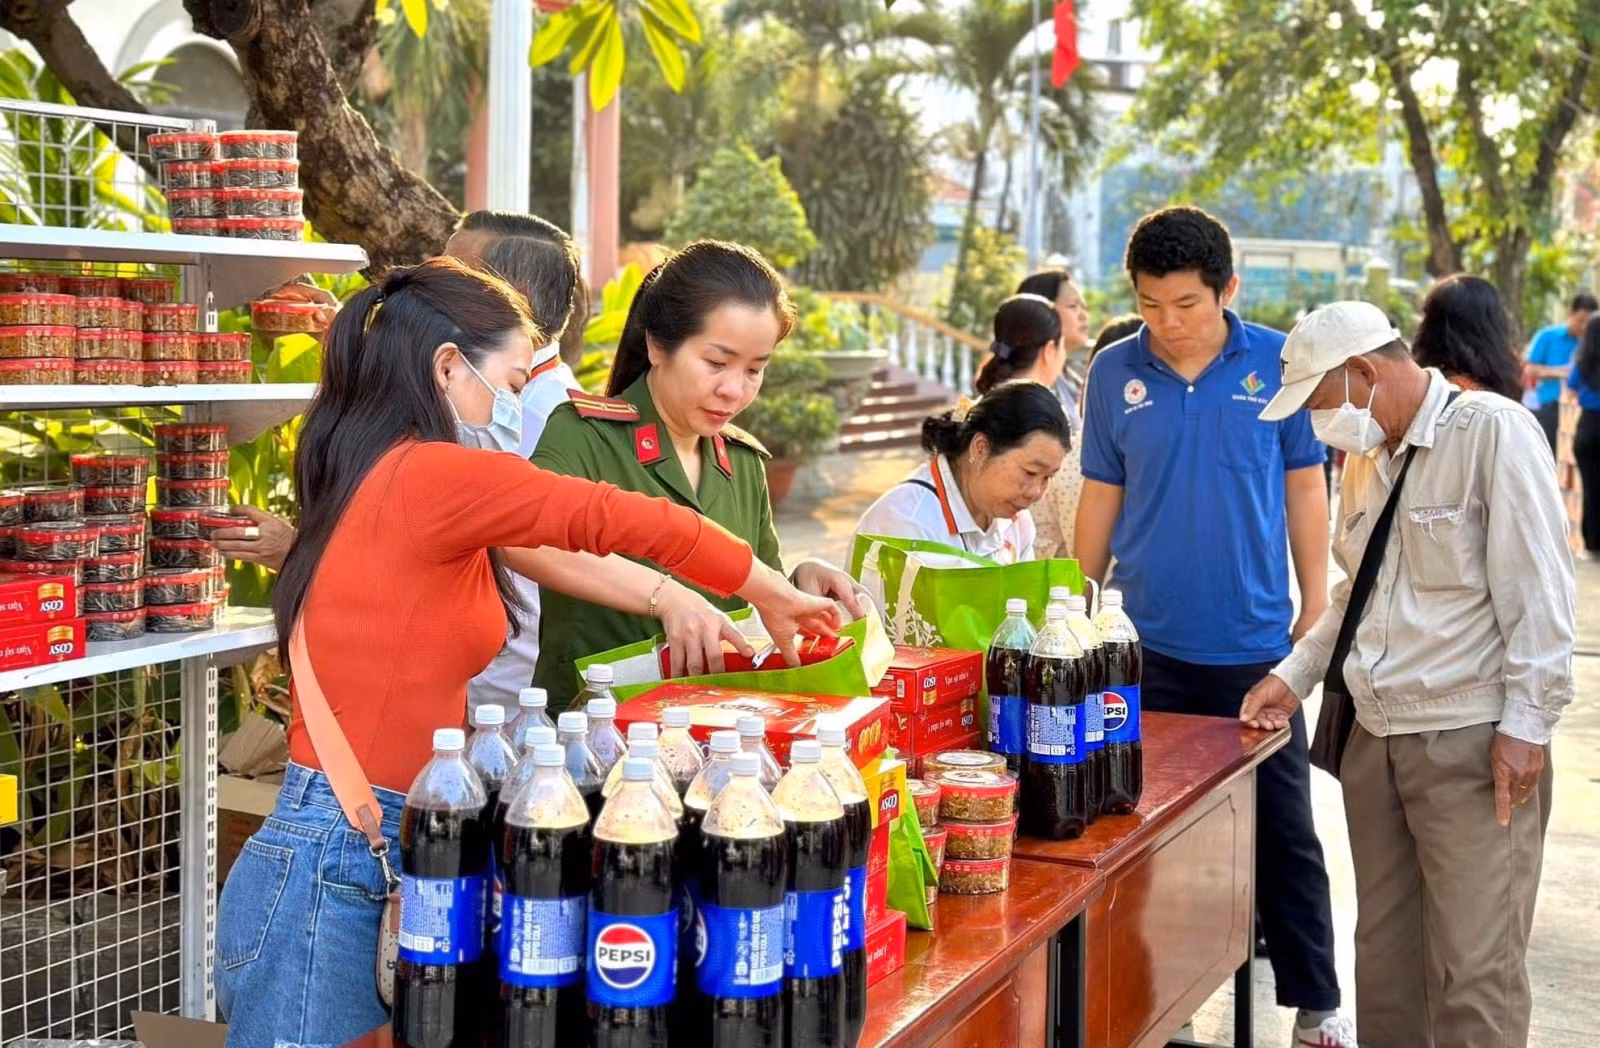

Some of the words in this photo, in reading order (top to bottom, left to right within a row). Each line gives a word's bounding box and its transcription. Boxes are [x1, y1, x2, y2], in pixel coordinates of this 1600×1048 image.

[40, 600, 64, 612] COSY
[48, 642, 73, 655] COSY
[1104, 706, 1126, 716] PSI
[880, 793, 897, 811] COSY
[832, 894, 843, 967] PEPSI
[599, 946, 651, 963] PEPSI
